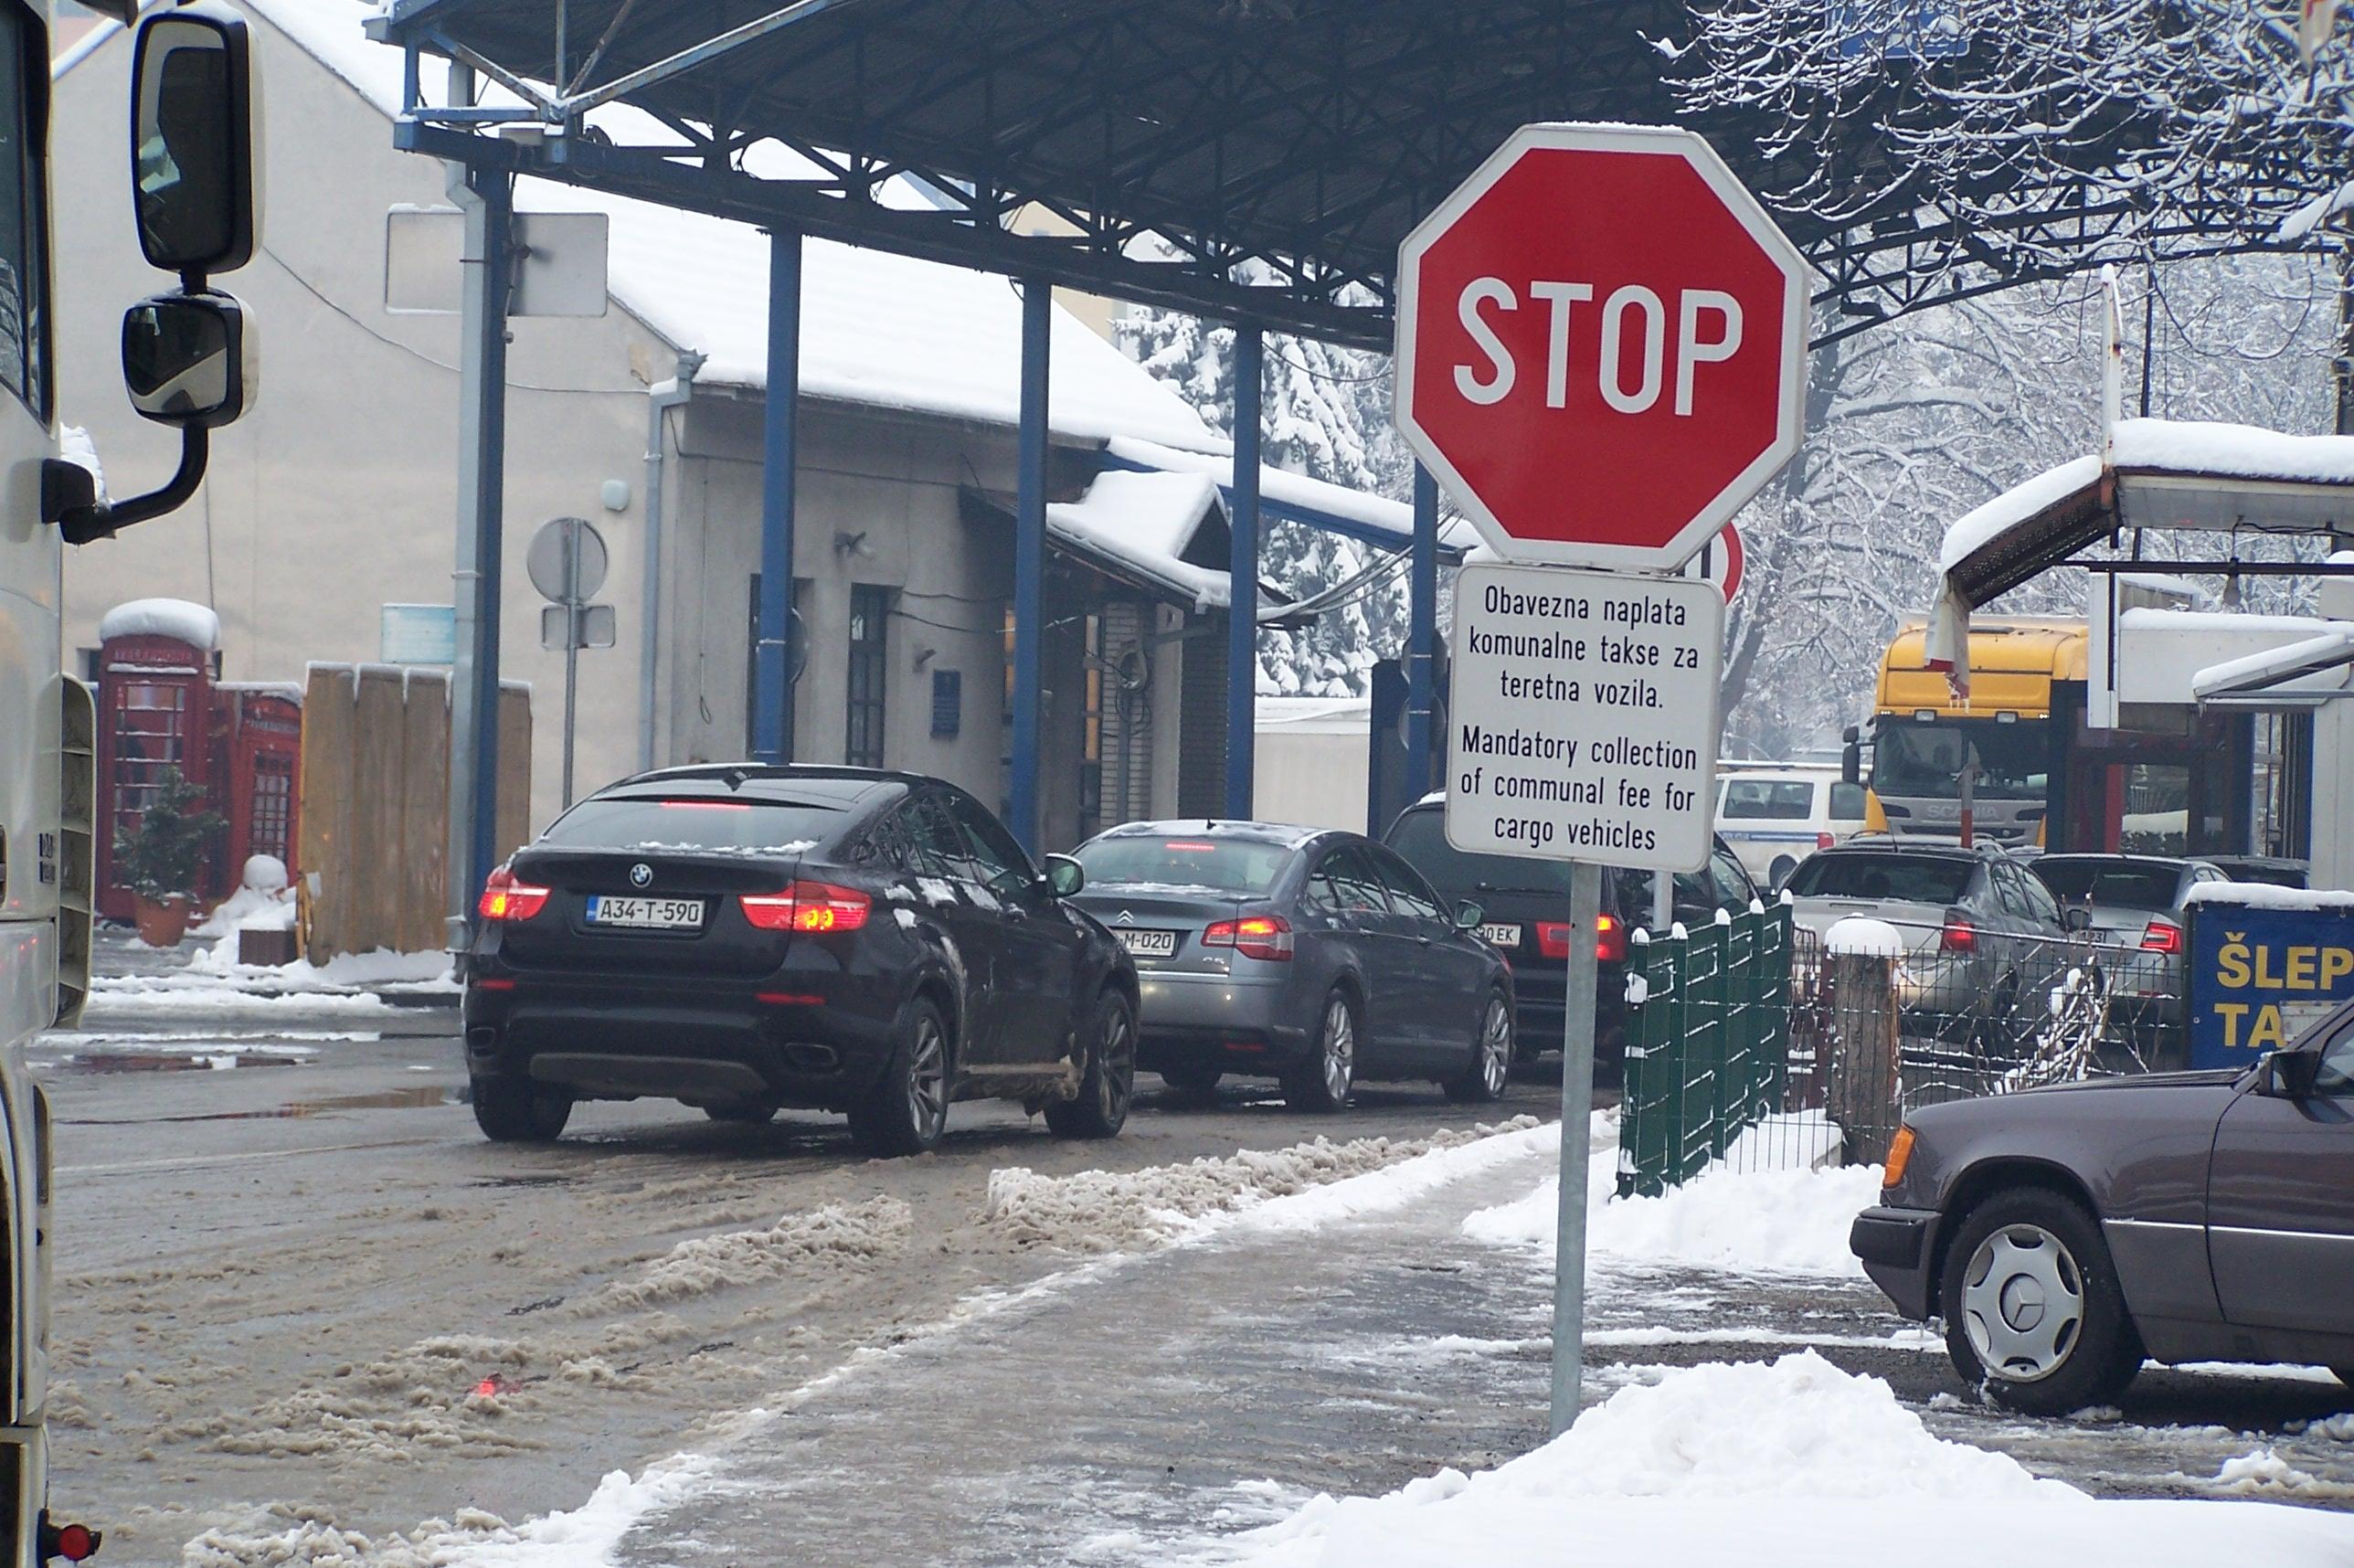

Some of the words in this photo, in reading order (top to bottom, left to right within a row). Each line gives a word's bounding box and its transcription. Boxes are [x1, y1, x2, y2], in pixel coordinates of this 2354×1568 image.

[1454, 277, 1743, 416] STOP
[1485, 585, 1589, 620] Obavezna
[1604, 596, 1685, 630] naplata
[1469, 626, 1585, 661] komunalne
[1601, 636, 1659, 666] takse
[1674, 646, 1698, 669] za
[1501, 670, 1579, 702] teretna
[1595, 679, 1663, 708] vozila.
[1462, 725, 1578, 768] Mandatory
[1591, 736, 1697, 770] collection
[1461, 767, 1483, 794] of
[1494, 775, 1604, 804] communal
[1618, 778, 1650, 808] fee
[1666, 782, 1696, 811] for
[1494, 817, 1553, 848] cargo
[1568, 818, 1656, 850] vehicles
[599, 899, 699, 922] A34-T-590
[2217, 931, 2354, 990] ŠLEP
